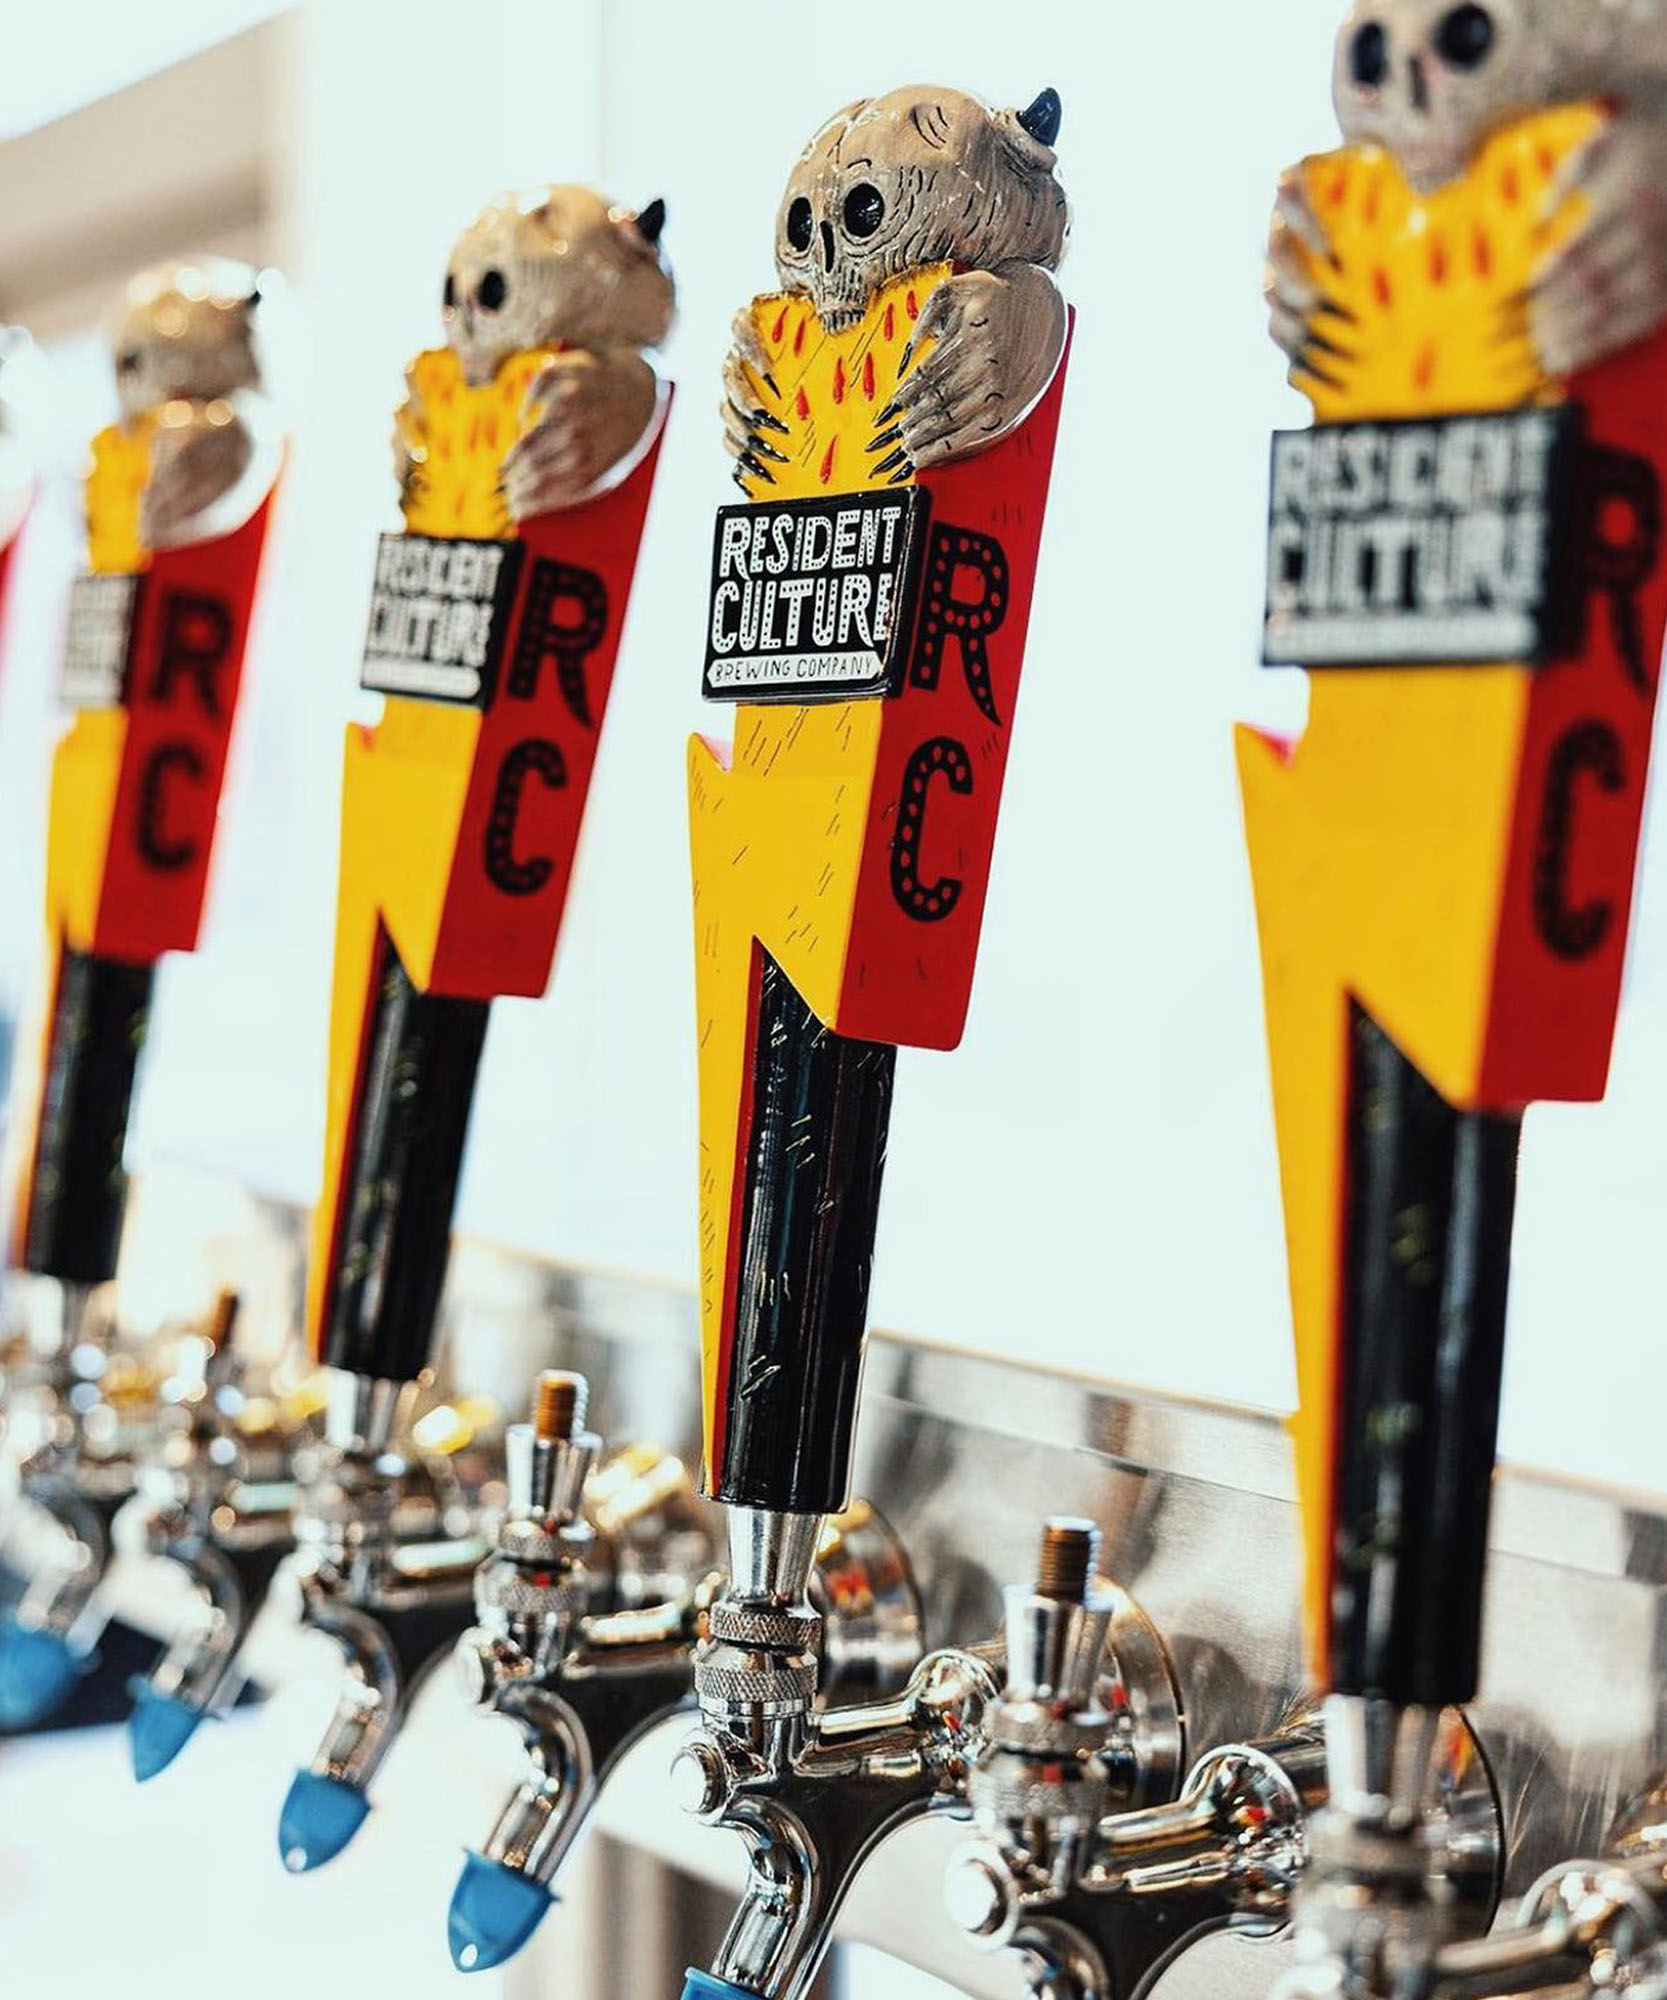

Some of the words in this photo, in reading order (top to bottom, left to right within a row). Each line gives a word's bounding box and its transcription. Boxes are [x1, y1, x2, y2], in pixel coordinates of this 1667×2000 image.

[719, 507, 901, 579] RESIDENT
[712, 573, 893, 652] CULTURE
[715, 660, 791, 682] BREWING
[796, 656, 873, 677] COMPANY
